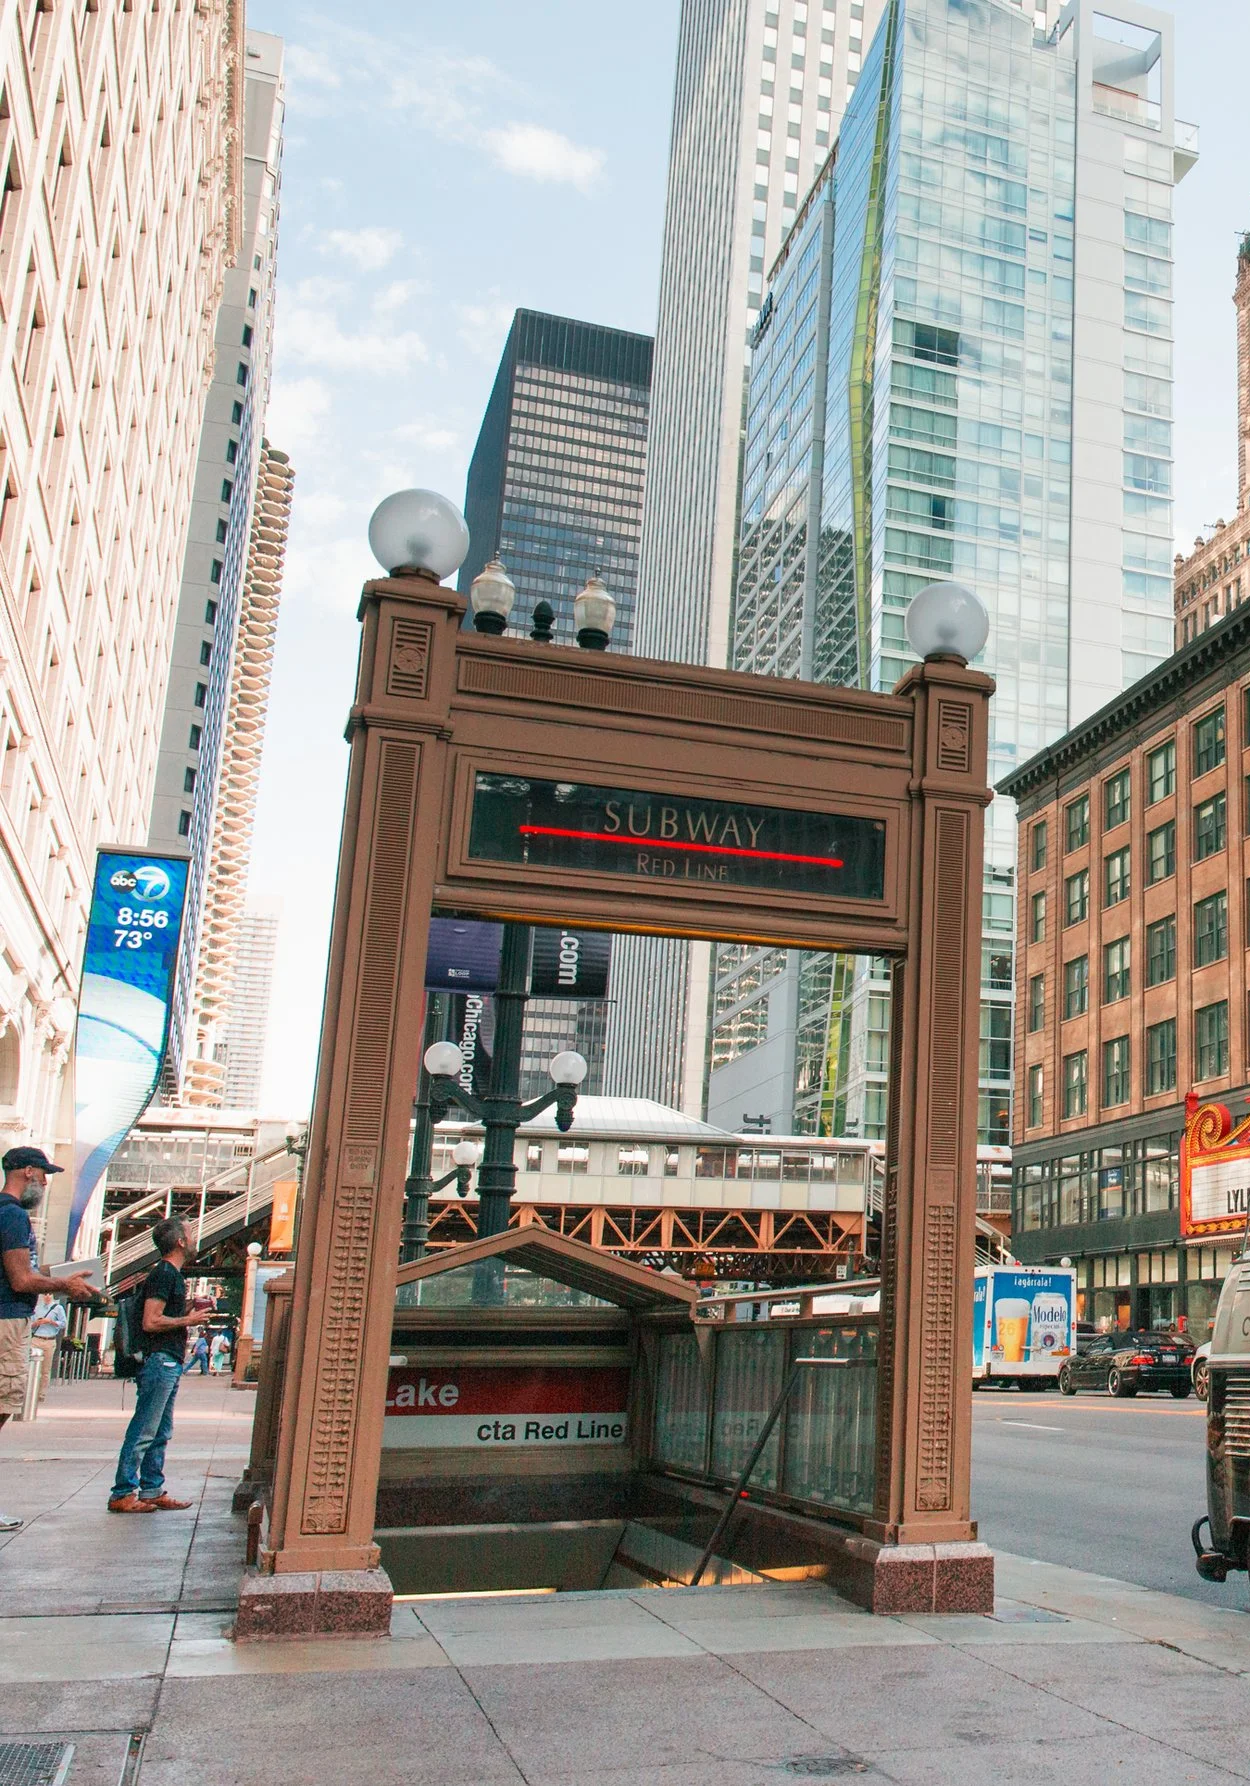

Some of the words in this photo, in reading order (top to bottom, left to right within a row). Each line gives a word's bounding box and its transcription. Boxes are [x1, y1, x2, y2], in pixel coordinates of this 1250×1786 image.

[603, 800, 765, 848] SUBWAY
[110, 874, 137, 887] abc
[135, 868, 168, 900] 7
[117, 906, 169, 929] 8:56
[114, 929, 153, 949] 73°
[1033, 1305, 1067, 1323] Modelo
[476, 1420, 516, 1442] cta
[524, 1420, 569, 1441] Red
[577, 1419, 623, 1440] Line
